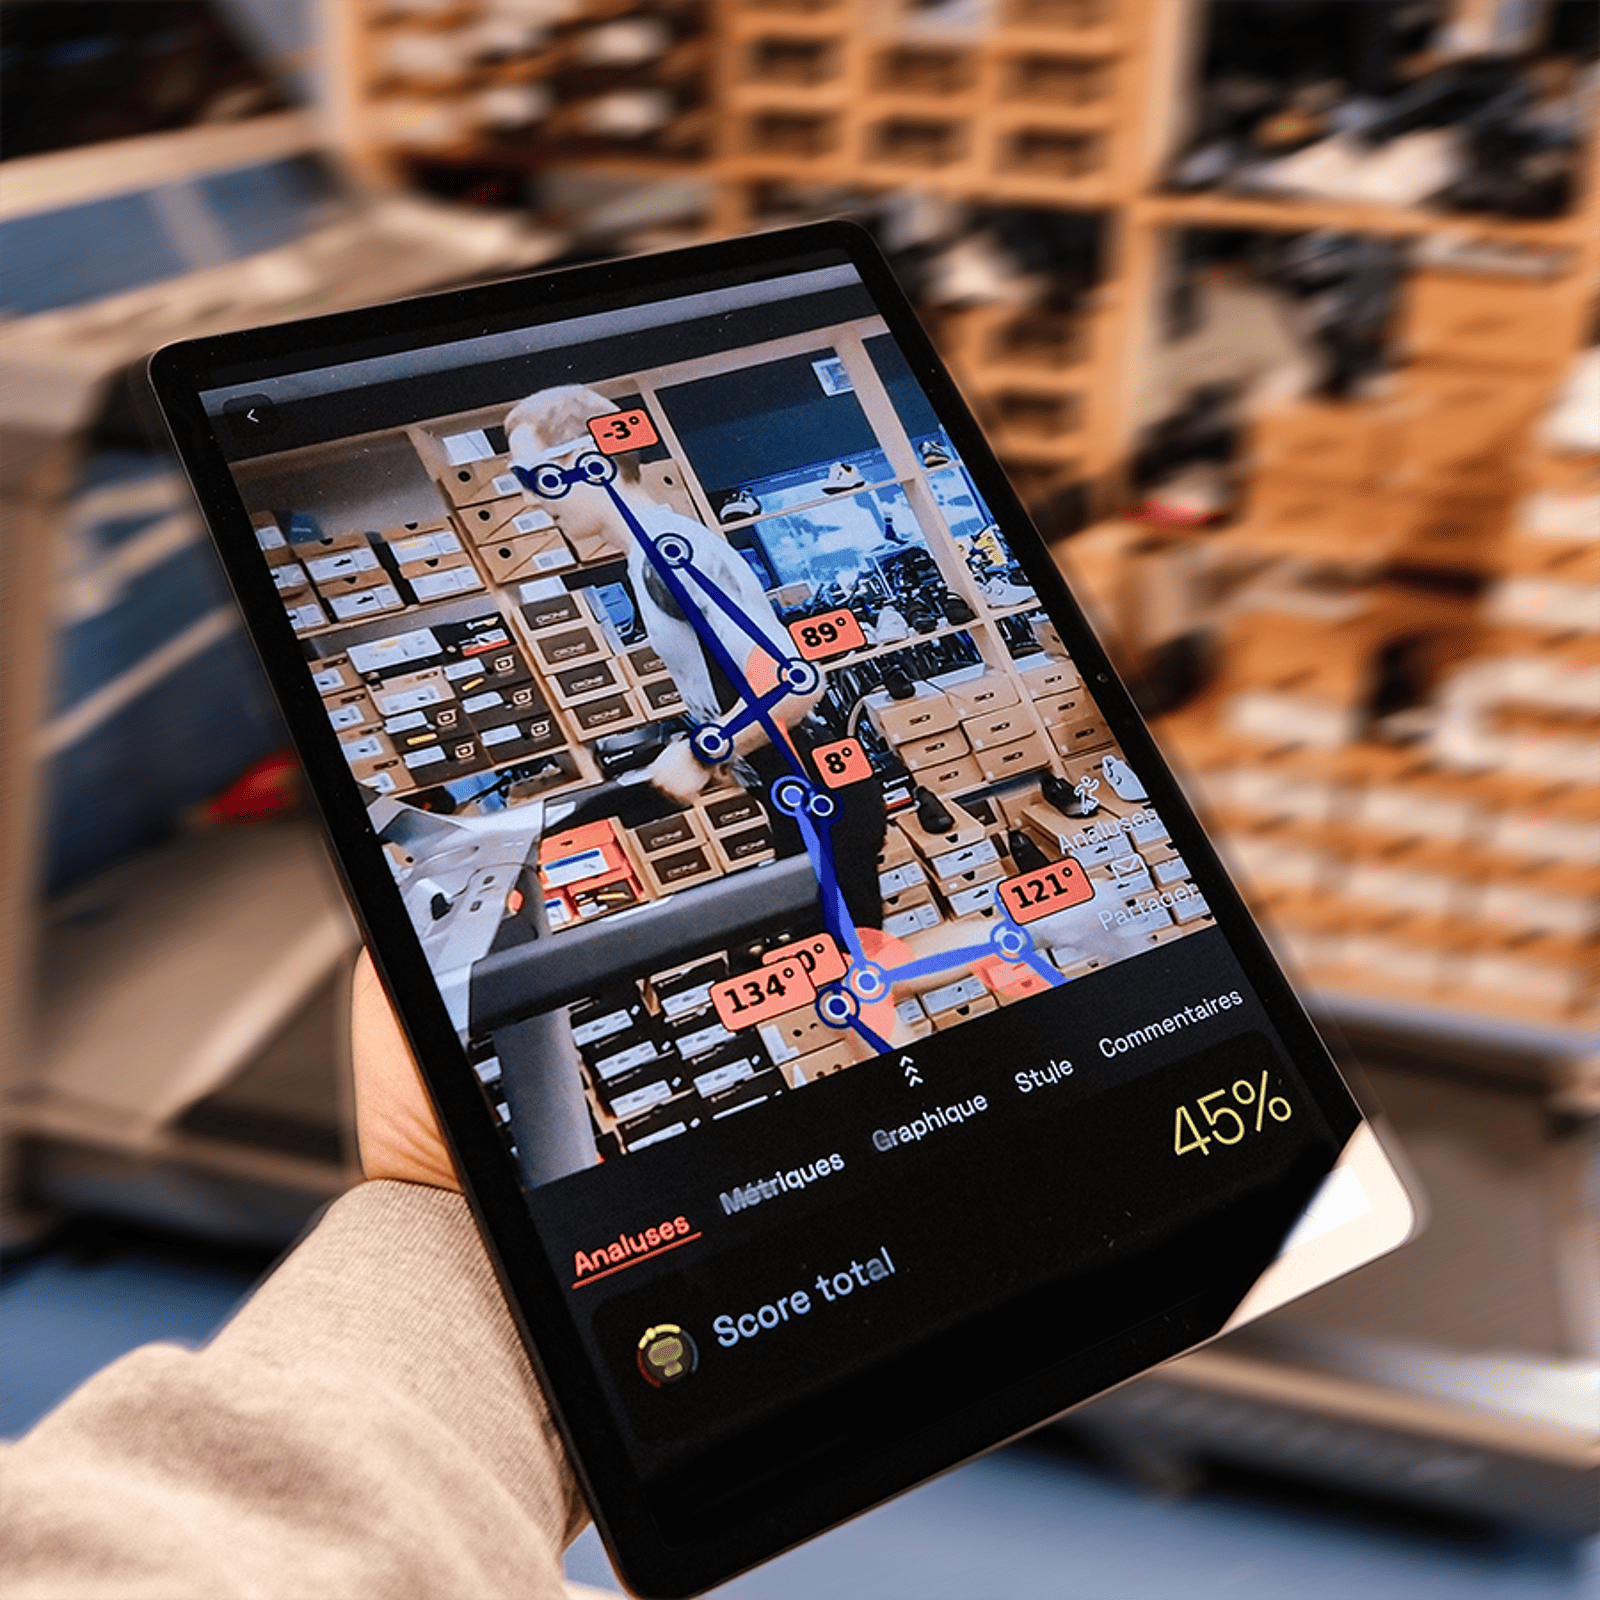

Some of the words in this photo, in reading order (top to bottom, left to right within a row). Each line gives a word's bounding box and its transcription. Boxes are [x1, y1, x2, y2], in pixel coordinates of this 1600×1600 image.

[603, 416, 640, 440] -3°
[801, 616, 846, 648] 89°
[824, 746, 852, 774] 8°
[1011, 866, 1073, 909] 121°
[724, 966, 795, 1014] 134°
[718, 1152, 845, 1216] Métriques
[872, 1094, 988, 1152] Graphique
[1014, 1058, 1074, 1093] Style
[1099, 990, 1244, 1058] Commentaires
[1174, 1069, 1292, 1156] 45%
[713, 1291, 811, 1348] Score
[815, 1245, 896, 1302] total
